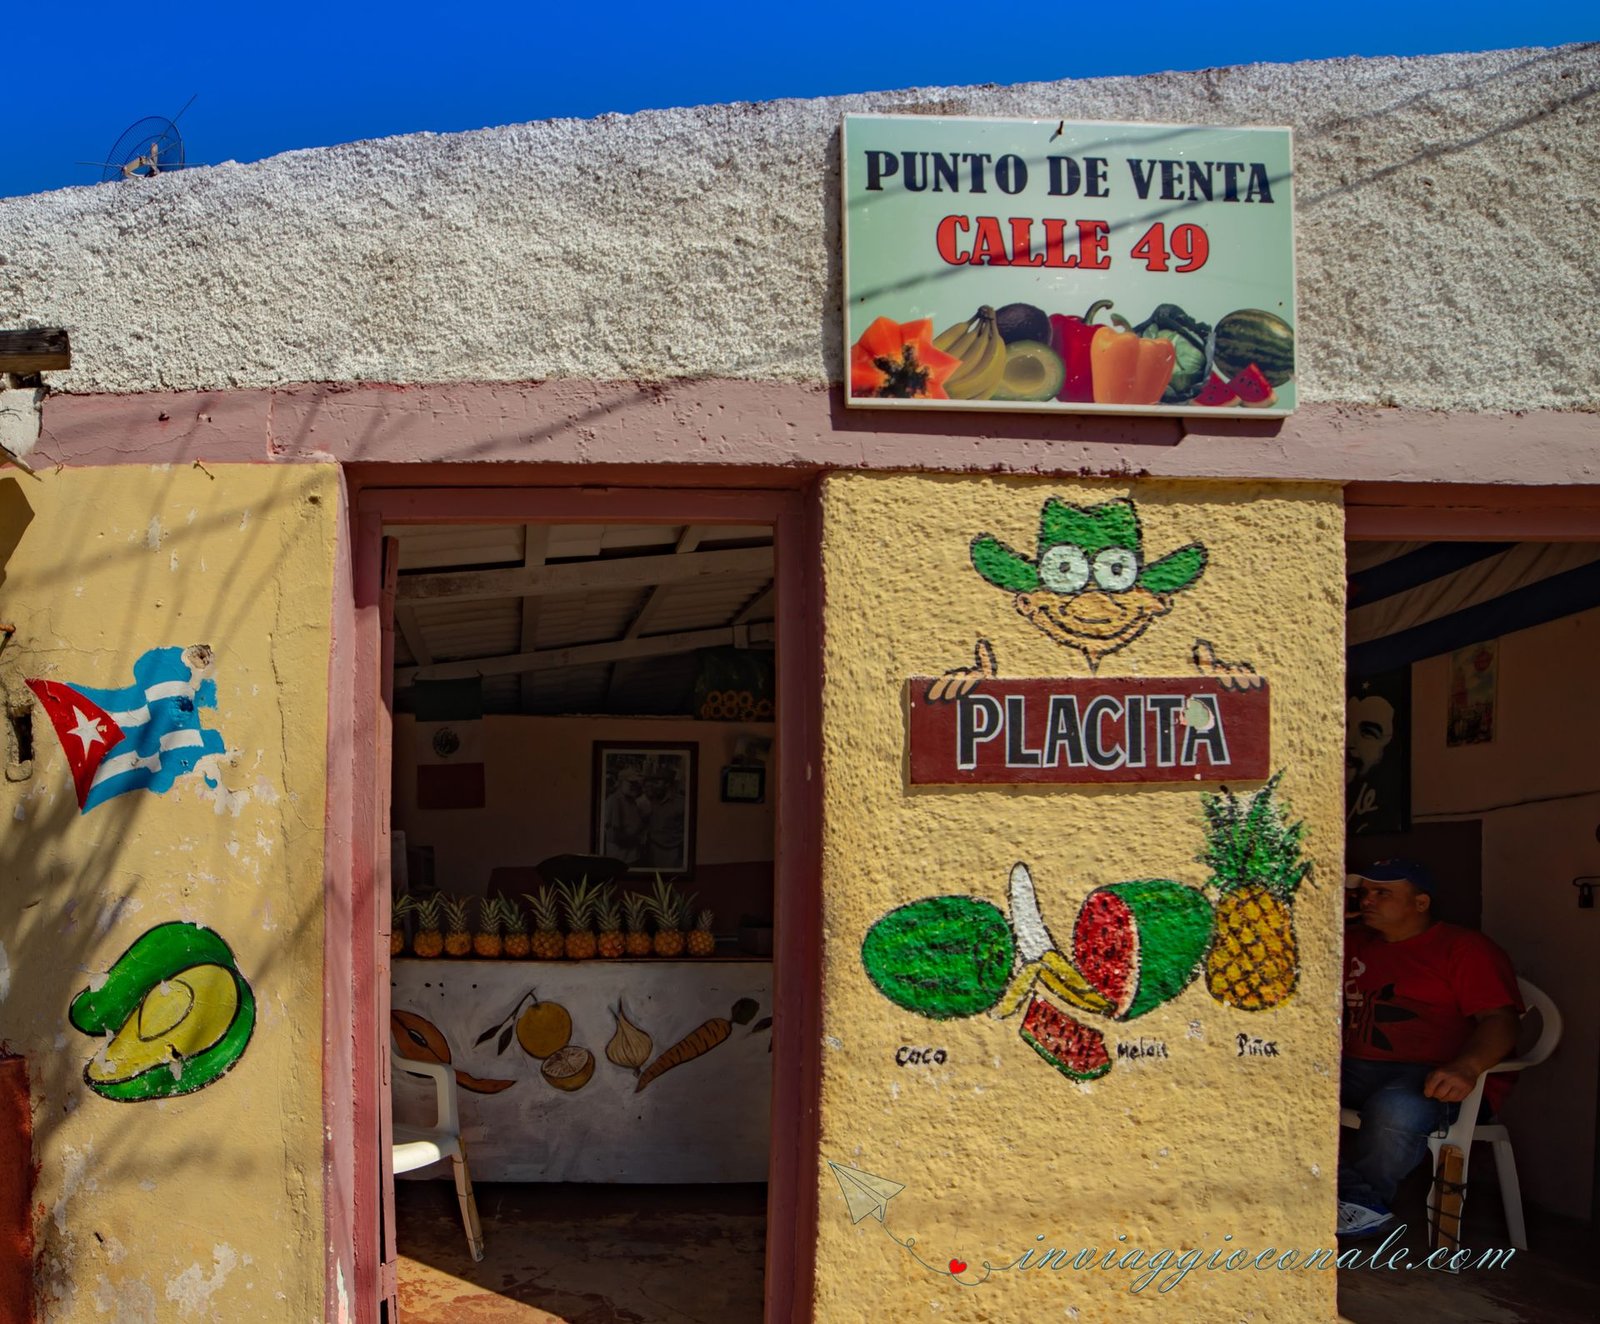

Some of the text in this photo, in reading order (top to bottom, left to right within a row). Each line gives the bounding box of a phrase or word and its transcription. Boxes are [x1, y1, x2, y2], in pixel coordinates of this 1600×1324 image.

[864, 150, 1275, 204] PUNTO DE VENTA
[936, 214, 1210, 273] CALLE 49
[956, 693, 1232, 771] PLACITA
[1235, 1032, 1281, 1058] Piña
